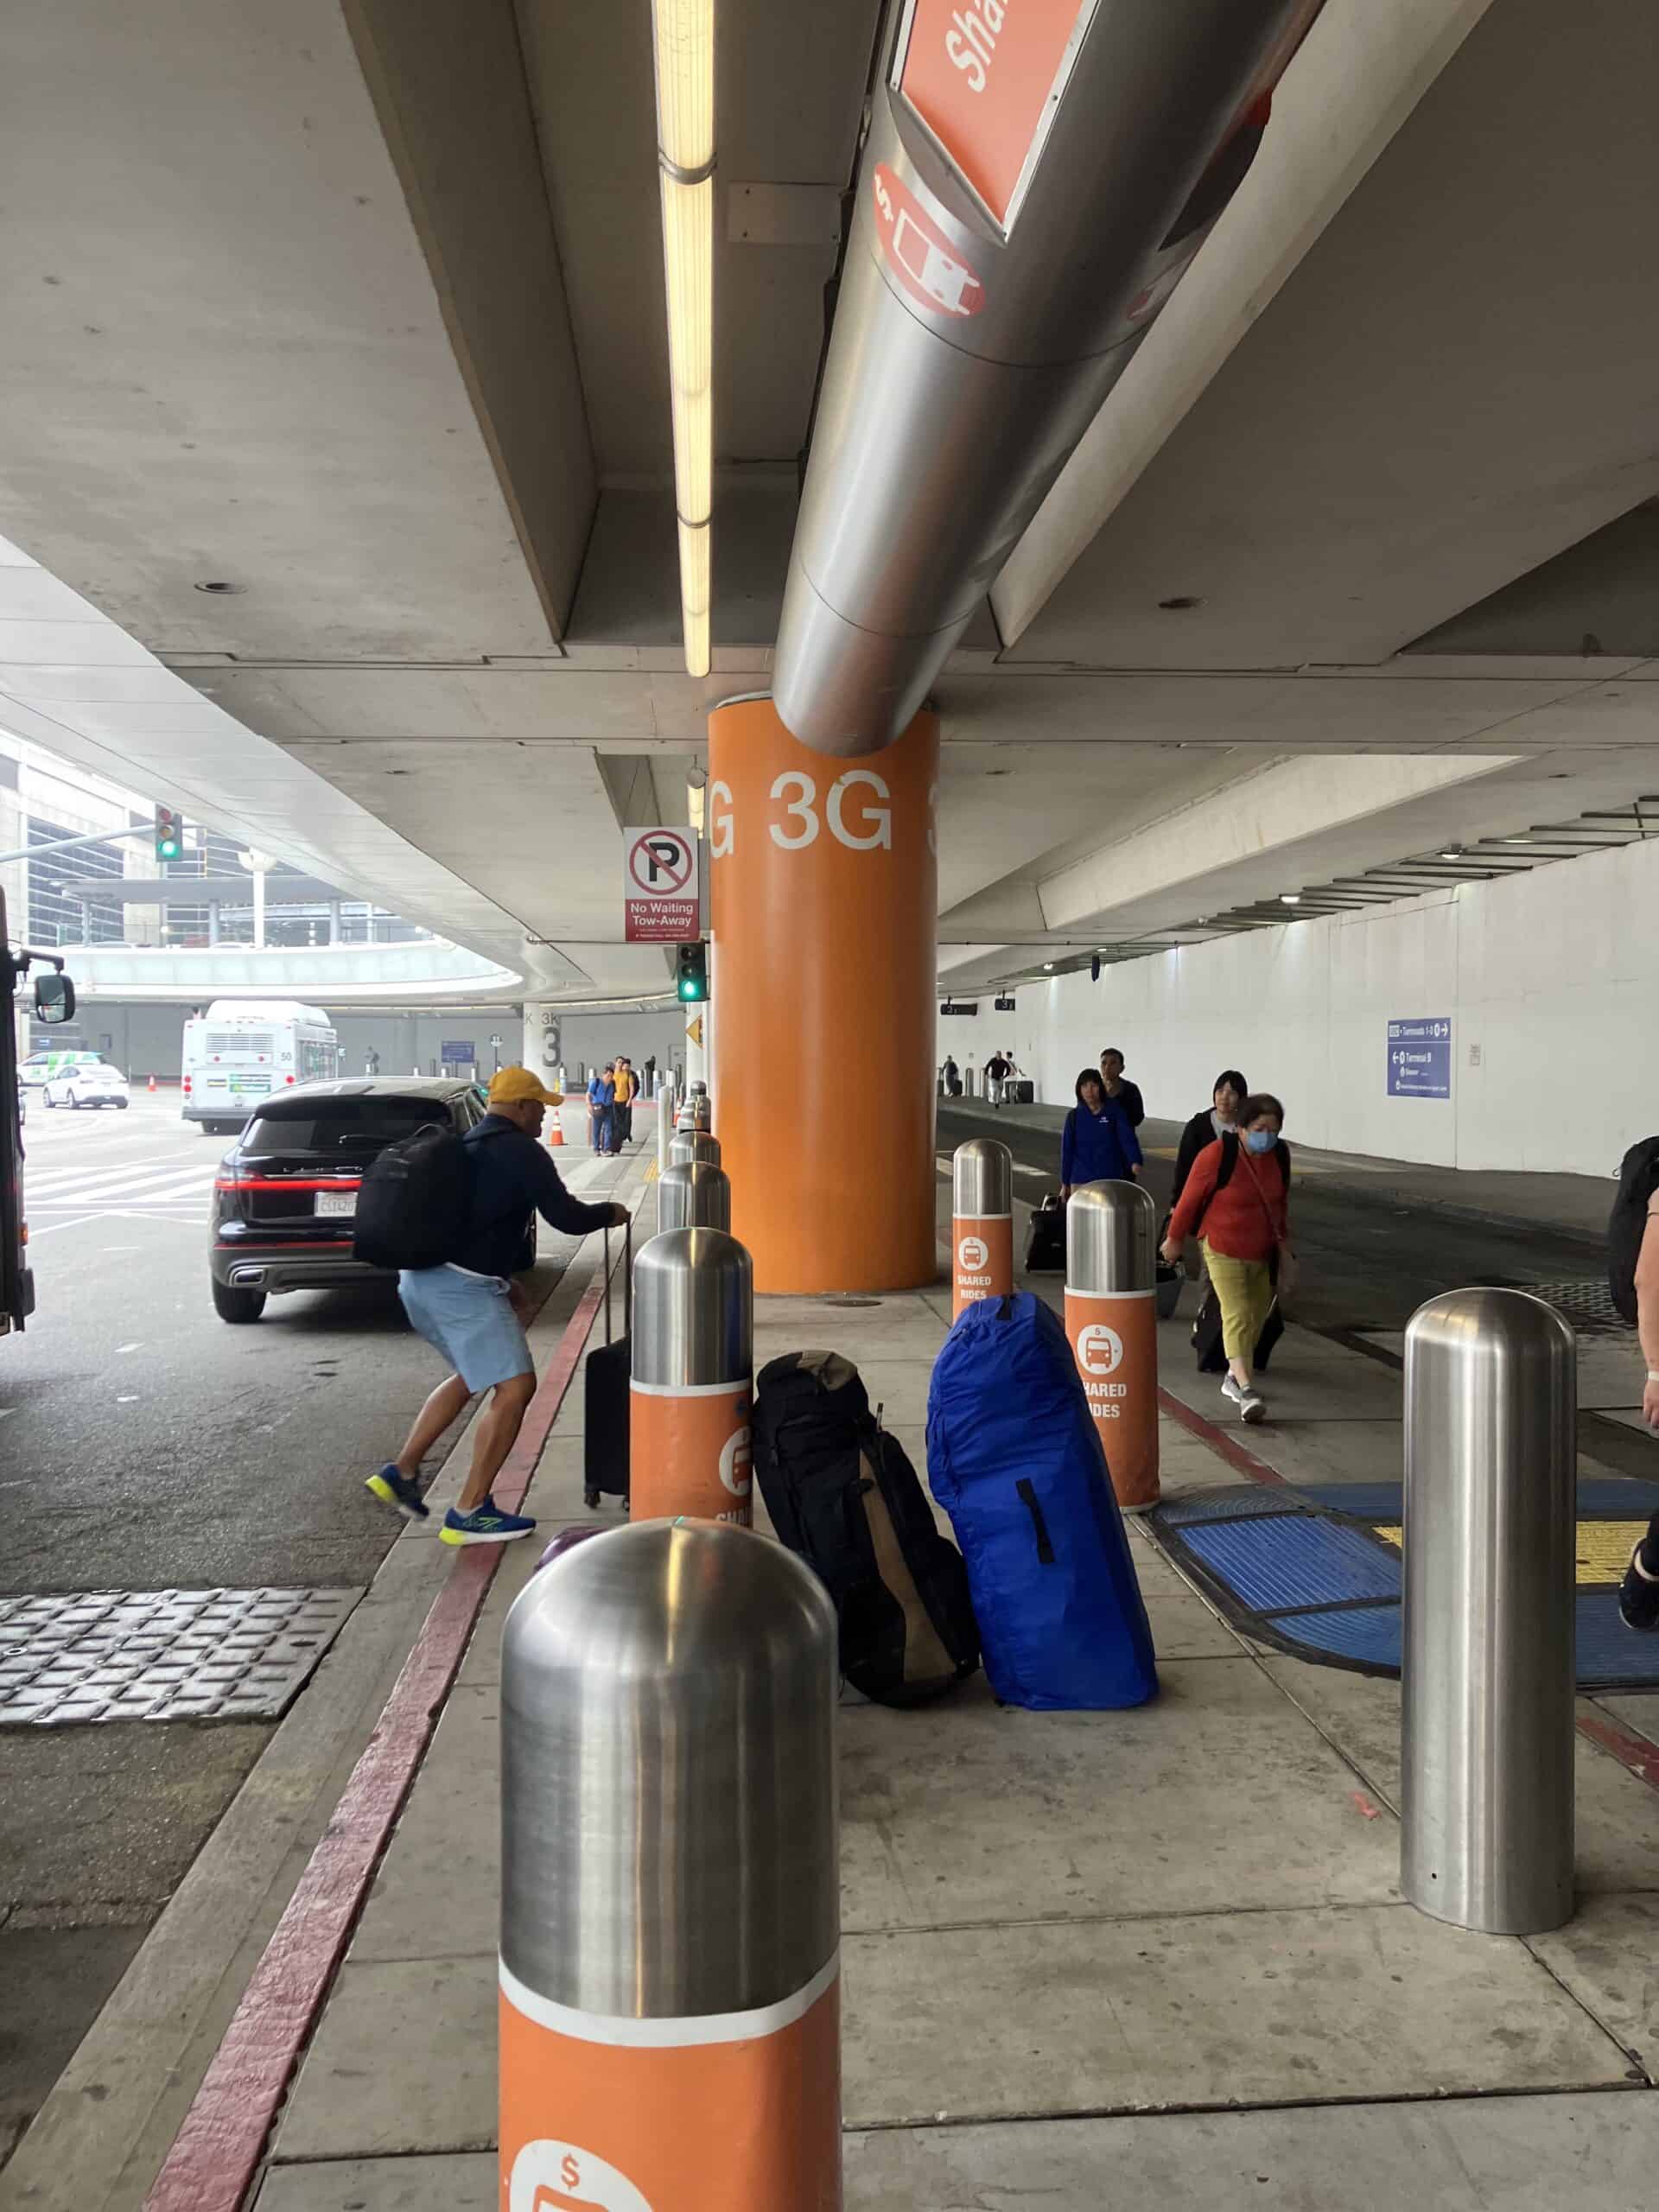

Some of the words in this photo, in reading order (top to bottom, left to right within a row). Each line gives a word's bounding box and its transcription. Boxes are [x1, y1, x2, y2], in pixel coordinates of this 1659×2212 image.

[768, 769, 893, 851] 3G
[709, 780, 734, 858] G
[630, 903, 647, 913] No
[650, 903, 694, 915] Waiting
[632, 915, 692, 927] Tow-Away
[543, 1026, 561, 1068] 3
[957, 1274, 992, 1287] SHARED
[960, 1288, 988, 1300] RIDES
[1083, 1382, 1128, 1397] HARED
[560, 2152, 580, 2190] $
